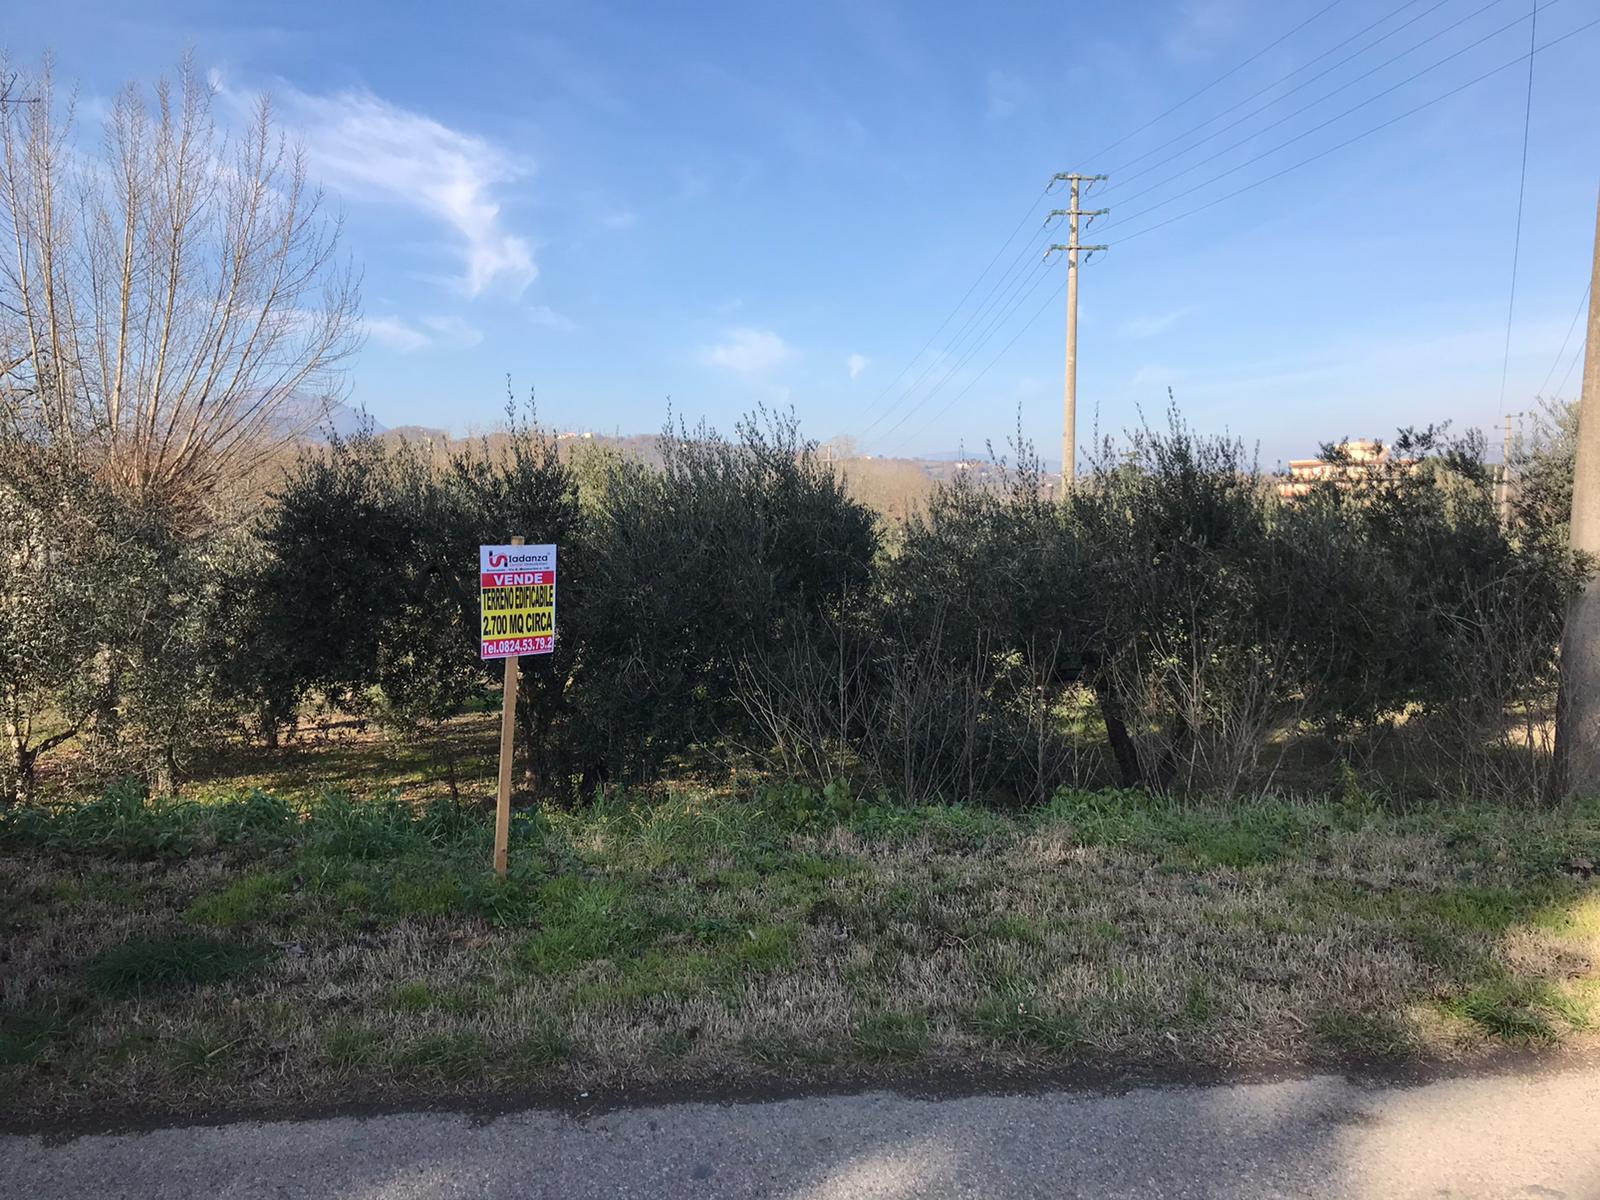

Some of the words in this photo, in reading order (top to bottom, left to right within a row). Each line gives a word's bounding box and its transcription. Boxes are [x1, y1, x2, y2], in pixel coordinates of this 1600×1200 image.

[493, 573, 543, 585] VENDE
[483, 587, 513, 610] TERRENO
[515, 585, 553, 609] EDIFICABILE
[483, 615, 508, 636] 2.700
[510, 613, 524, 634] MQ
[526, 612, 552, 632] CIRCA
